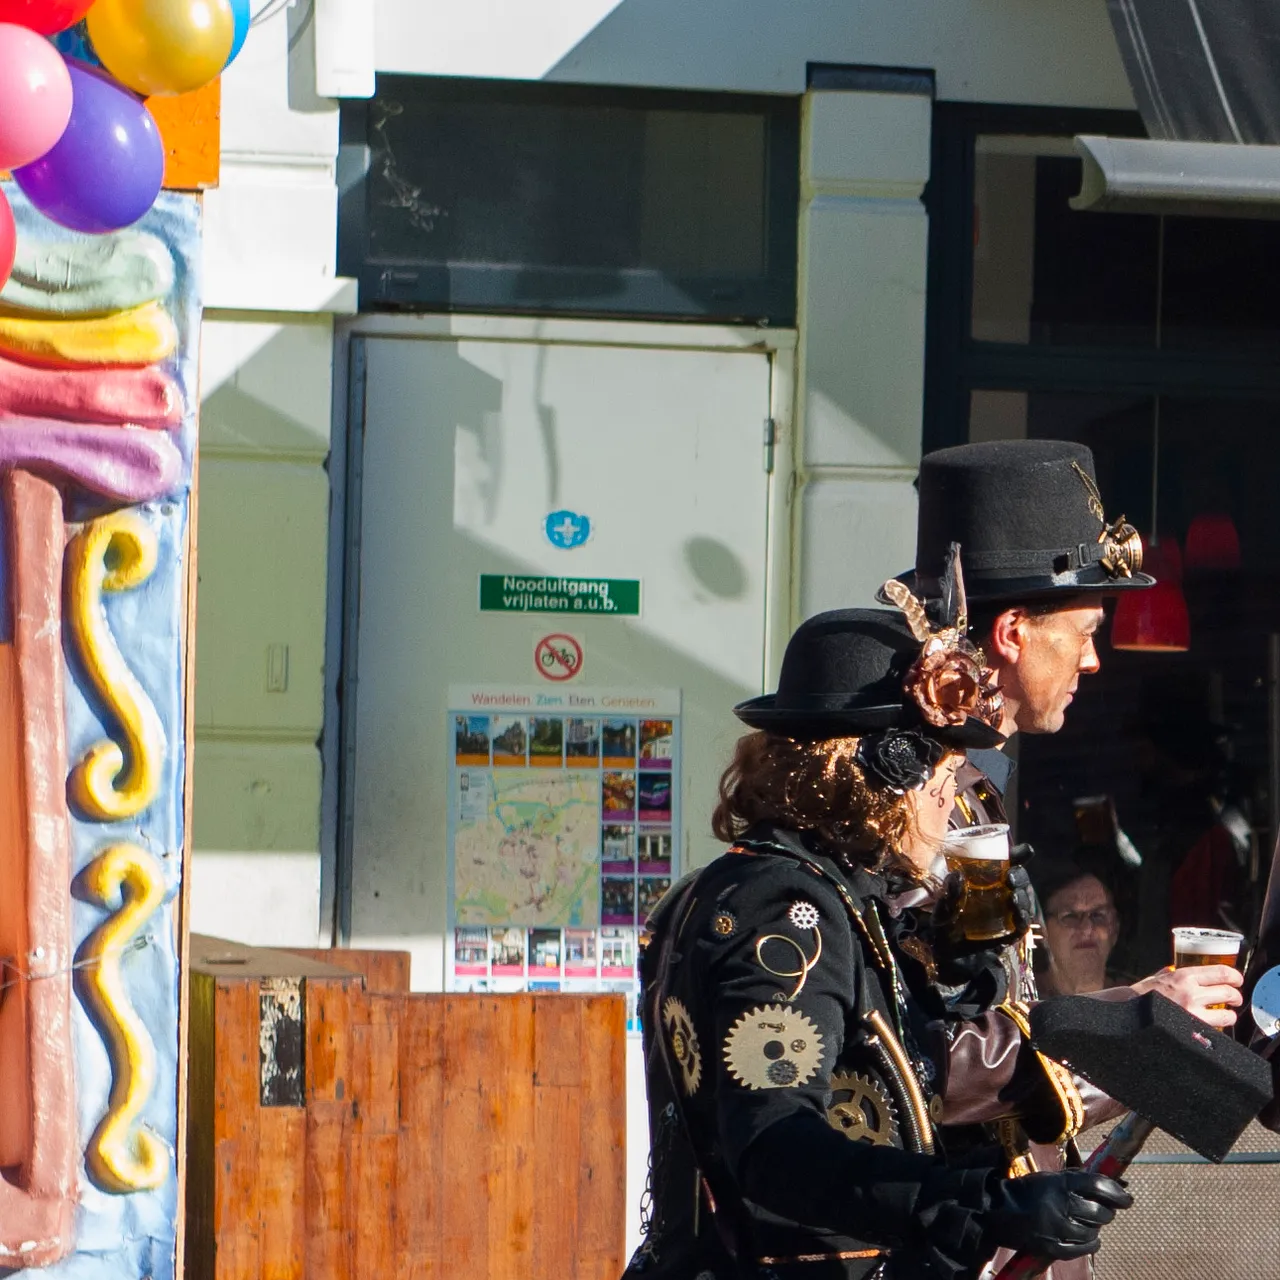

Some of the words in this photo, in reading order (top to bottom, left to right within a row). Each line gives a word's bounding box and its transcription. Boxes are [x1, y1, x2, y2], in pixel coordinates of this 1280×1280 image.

[503, 576, 609, 597] Nooduitgang
[502, 593, 568, 611] vrijlaten
[573, 595, 617, 611] a.u.b.
